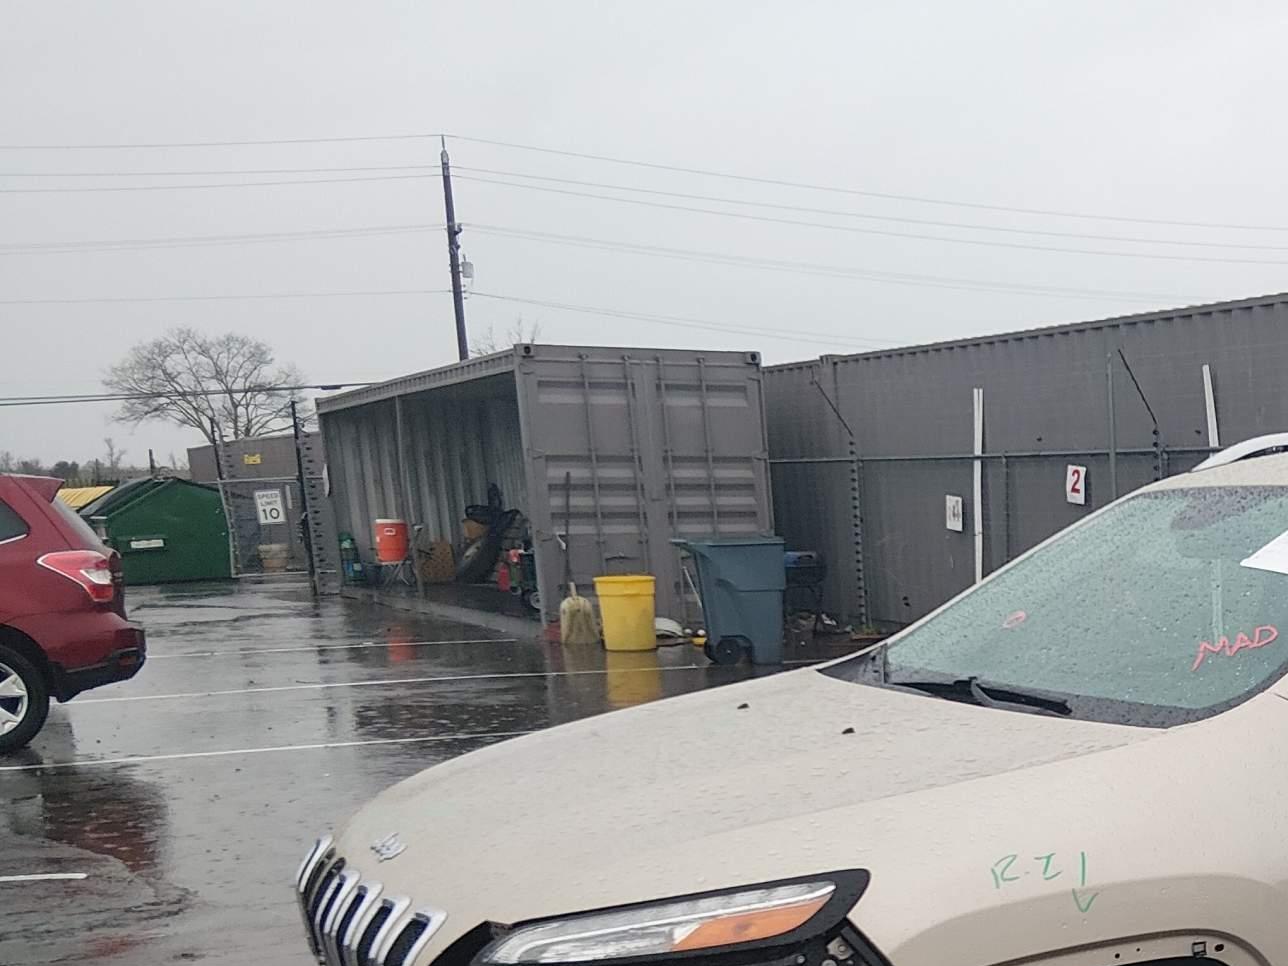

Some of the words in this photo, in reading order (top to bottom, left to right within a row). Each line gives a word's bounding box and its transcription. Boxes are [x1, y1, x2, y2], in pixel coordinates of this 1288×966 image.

[1070, 468, 1082, 494] 2
[262, 508, 280, 520] 10
[1191, 624, 1279, 672] MAD
